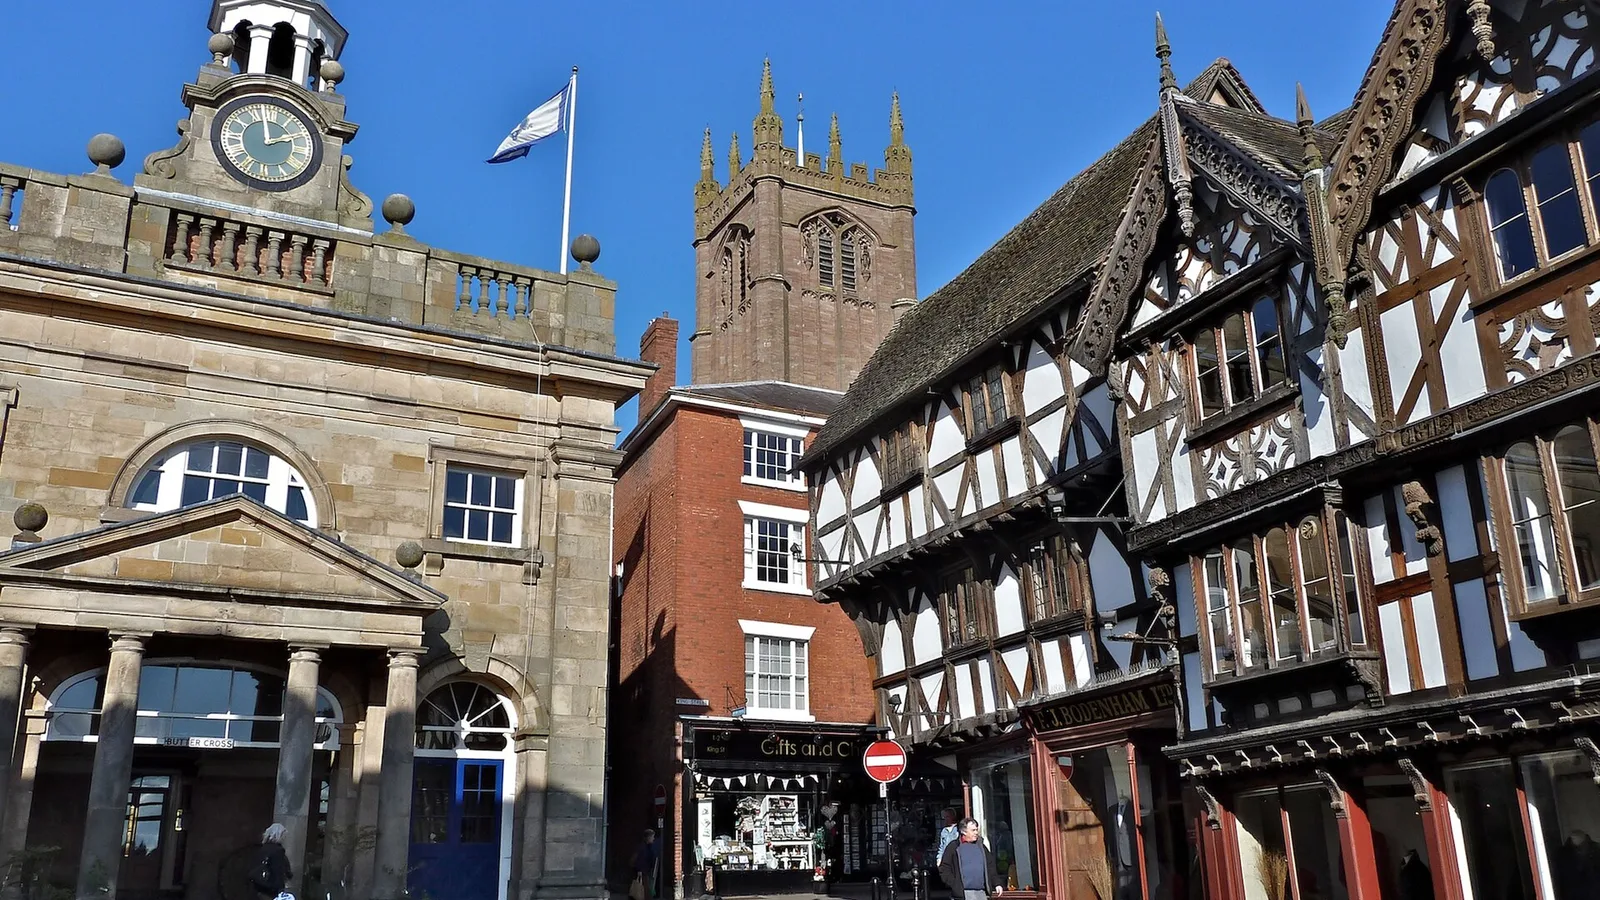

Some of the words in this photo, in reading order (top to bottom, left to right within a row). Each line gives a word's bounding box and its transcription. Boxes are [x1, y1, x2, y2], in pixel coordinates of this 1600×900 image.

[1061, 689, 1150, 724] BODENHAM
[167, 737, 201, 747] BUTTER
[203, 739, 232, 748] CROSS
[760, 738, 797, 756] Gifts
[801, 741, 833, 757] and
